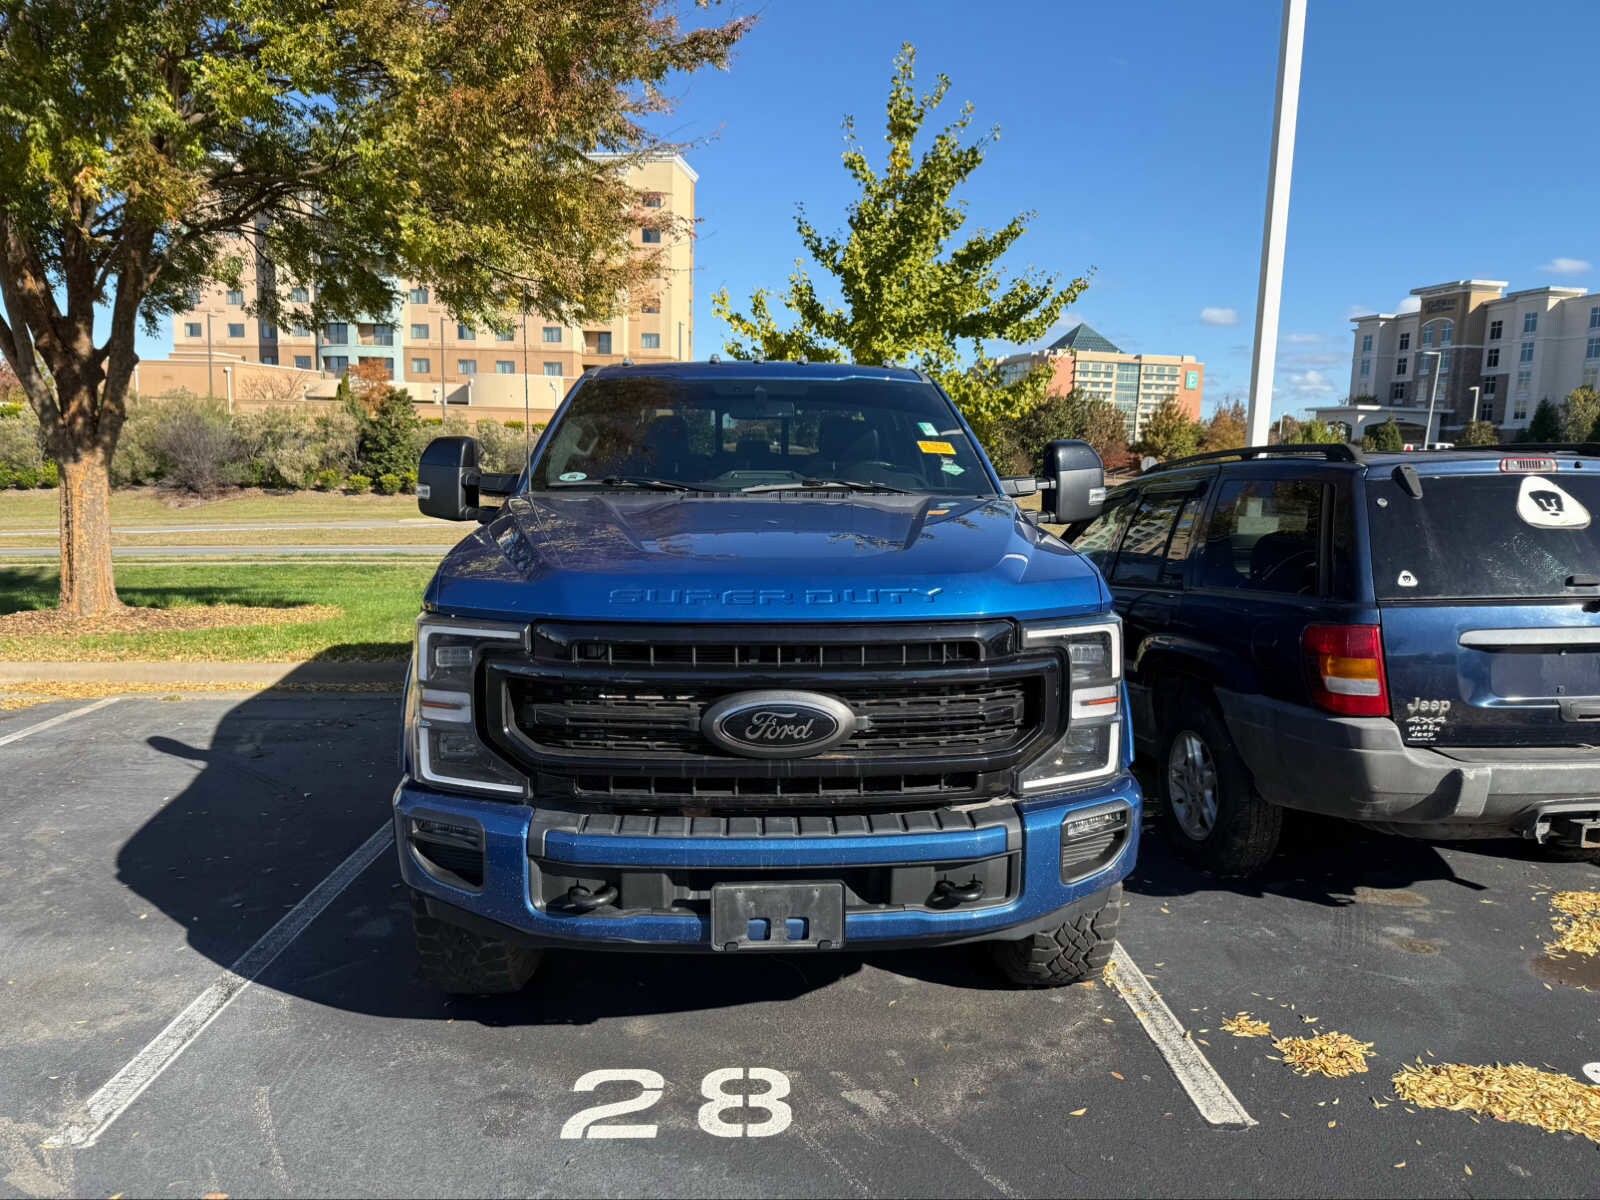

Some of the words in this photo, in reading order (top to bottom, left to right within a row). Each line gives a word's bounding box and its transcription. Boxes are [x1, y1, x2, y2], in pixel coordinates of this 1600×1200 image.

[608, 589, 793, 606] SUPER
[805, 587, 944, 604] DUTY
[1407, 697, 1451, 716] Jeep
[744, 711, 815, 740] Ford
